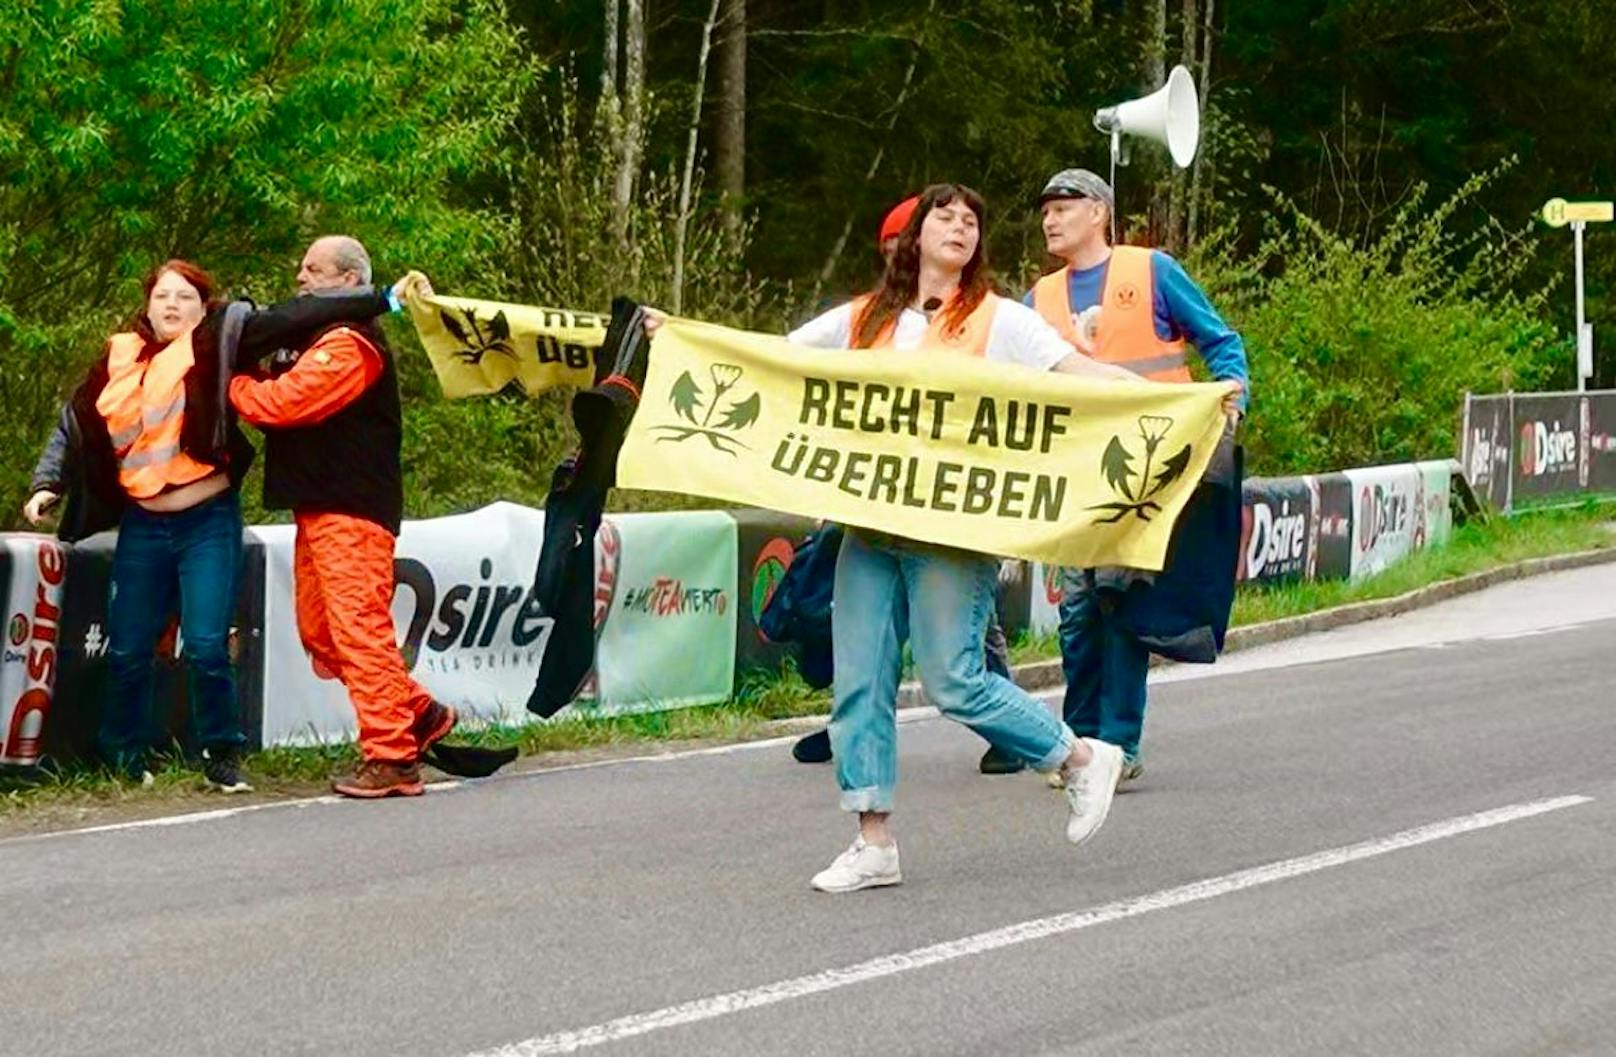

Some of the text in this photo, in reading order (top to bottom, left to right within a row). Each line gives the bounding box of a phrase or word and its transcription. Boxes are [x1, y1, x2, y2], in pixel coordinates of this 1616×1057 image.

[543, 309, 610, 328] RE
[799, 377, 1072, 453] RECHT AUF
[771, 431, 1067, 522] ÜBERLEBEN
[1247, 499, 1305, 578] Dsire
[6, 543, 66, 759] Dsire
[394, 557, 547, 672] Dsire
